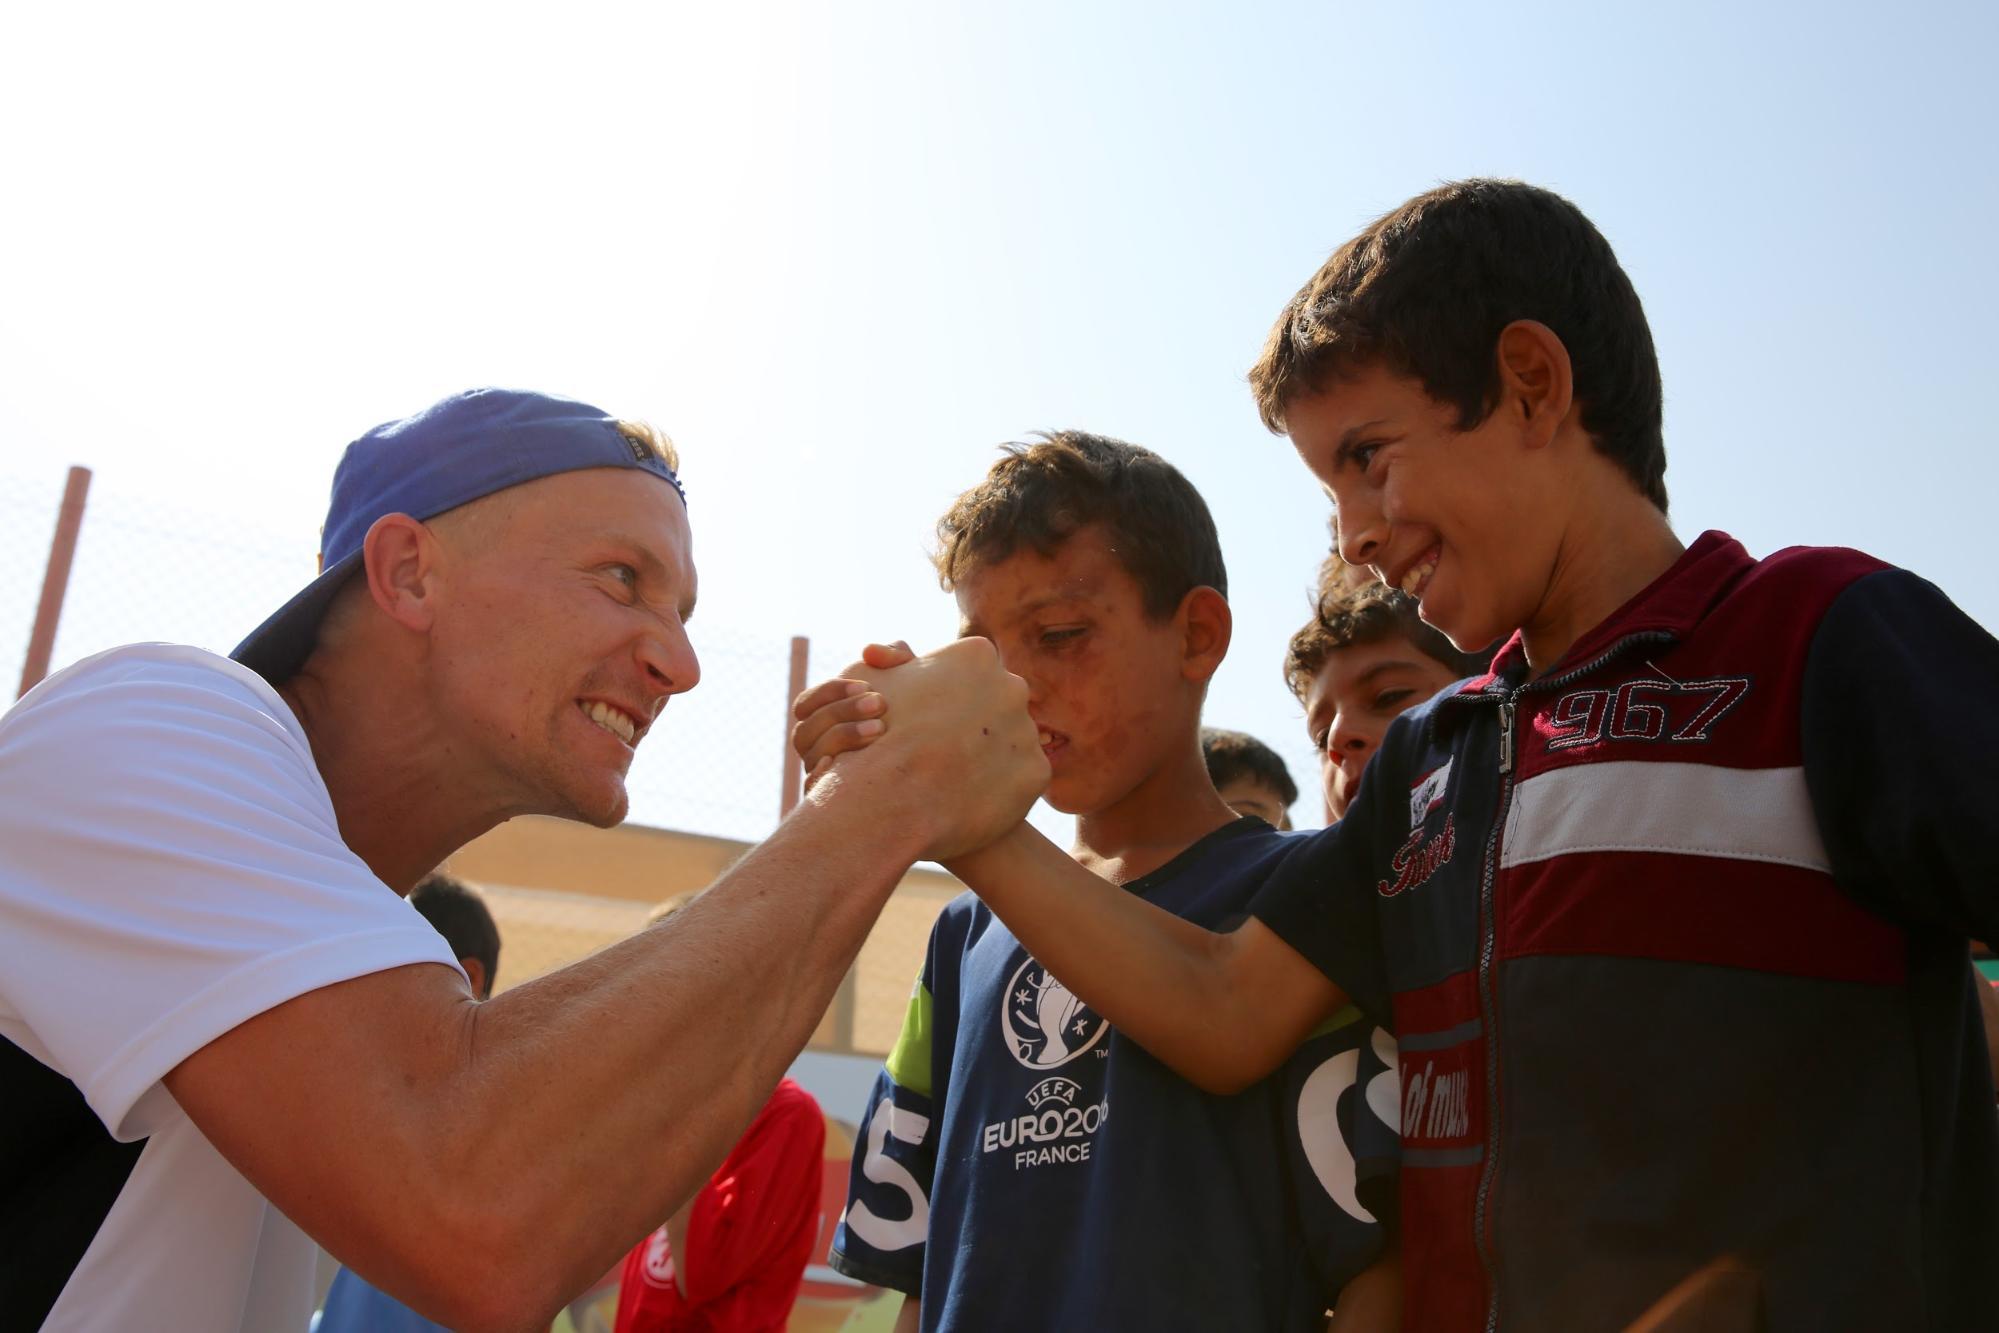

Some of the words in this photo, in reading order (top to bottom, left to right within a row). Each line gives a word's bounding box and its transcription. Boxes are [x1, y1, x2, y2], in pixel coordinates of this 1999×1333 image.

[1548, 678, 1747, 748] 967
[1094, 1048, 1110, 1058] TM
[1028, 1081, 1075, 1106] UEFA
[1015, 1142, 1091, 1170] FRANCE
[847, 1099, 930, 1251] 5
